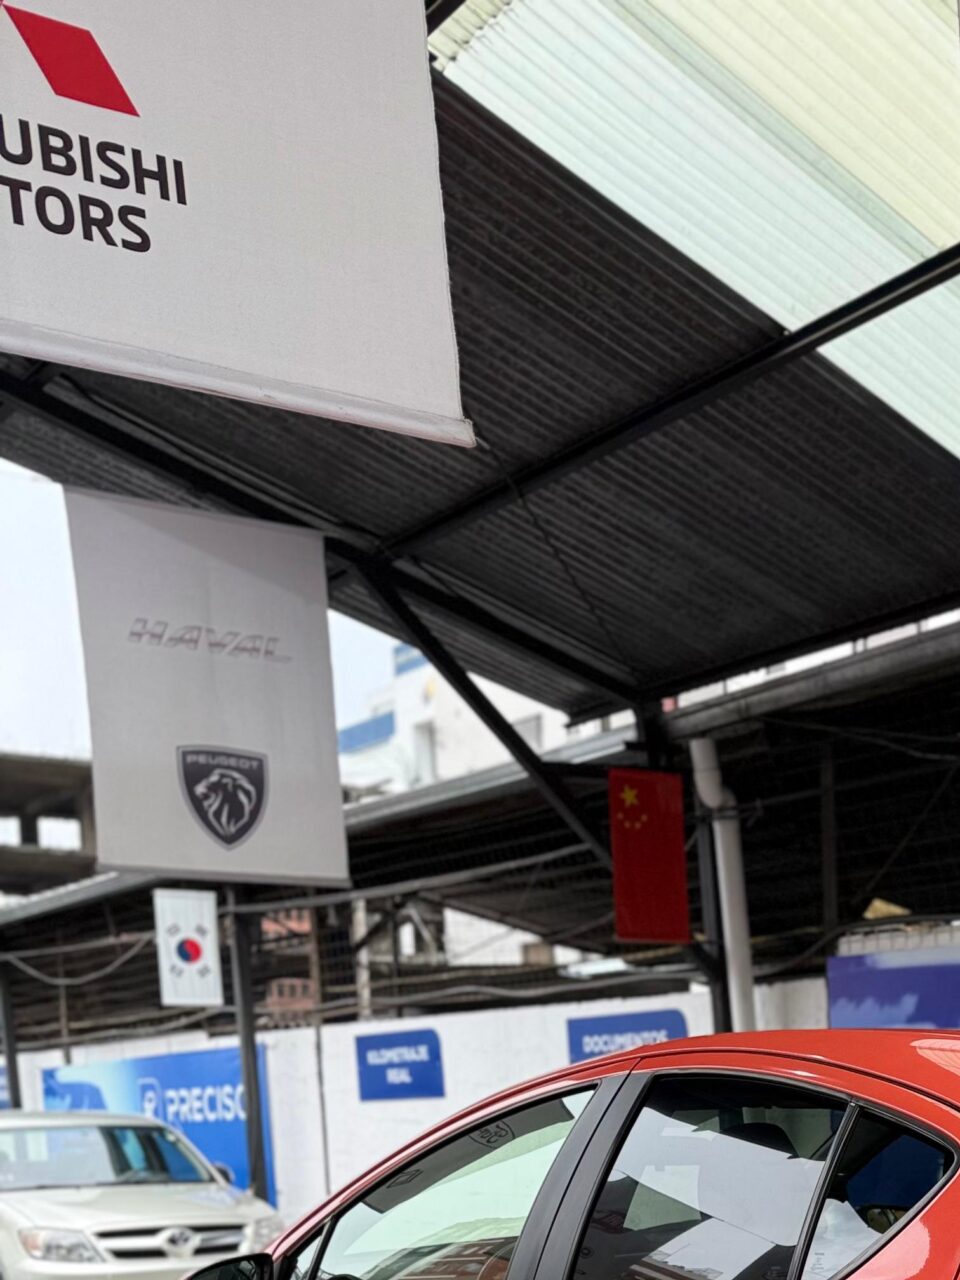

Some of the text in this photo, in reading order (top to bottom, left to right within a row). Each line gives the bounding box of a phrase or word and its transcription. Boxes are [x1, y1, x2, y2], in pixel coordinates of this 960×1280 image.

[0, 174, 151, 253] TORS
[128, 617, 293, 664] HAVAL
[185, 753, 260, 770] PEUGEOT
